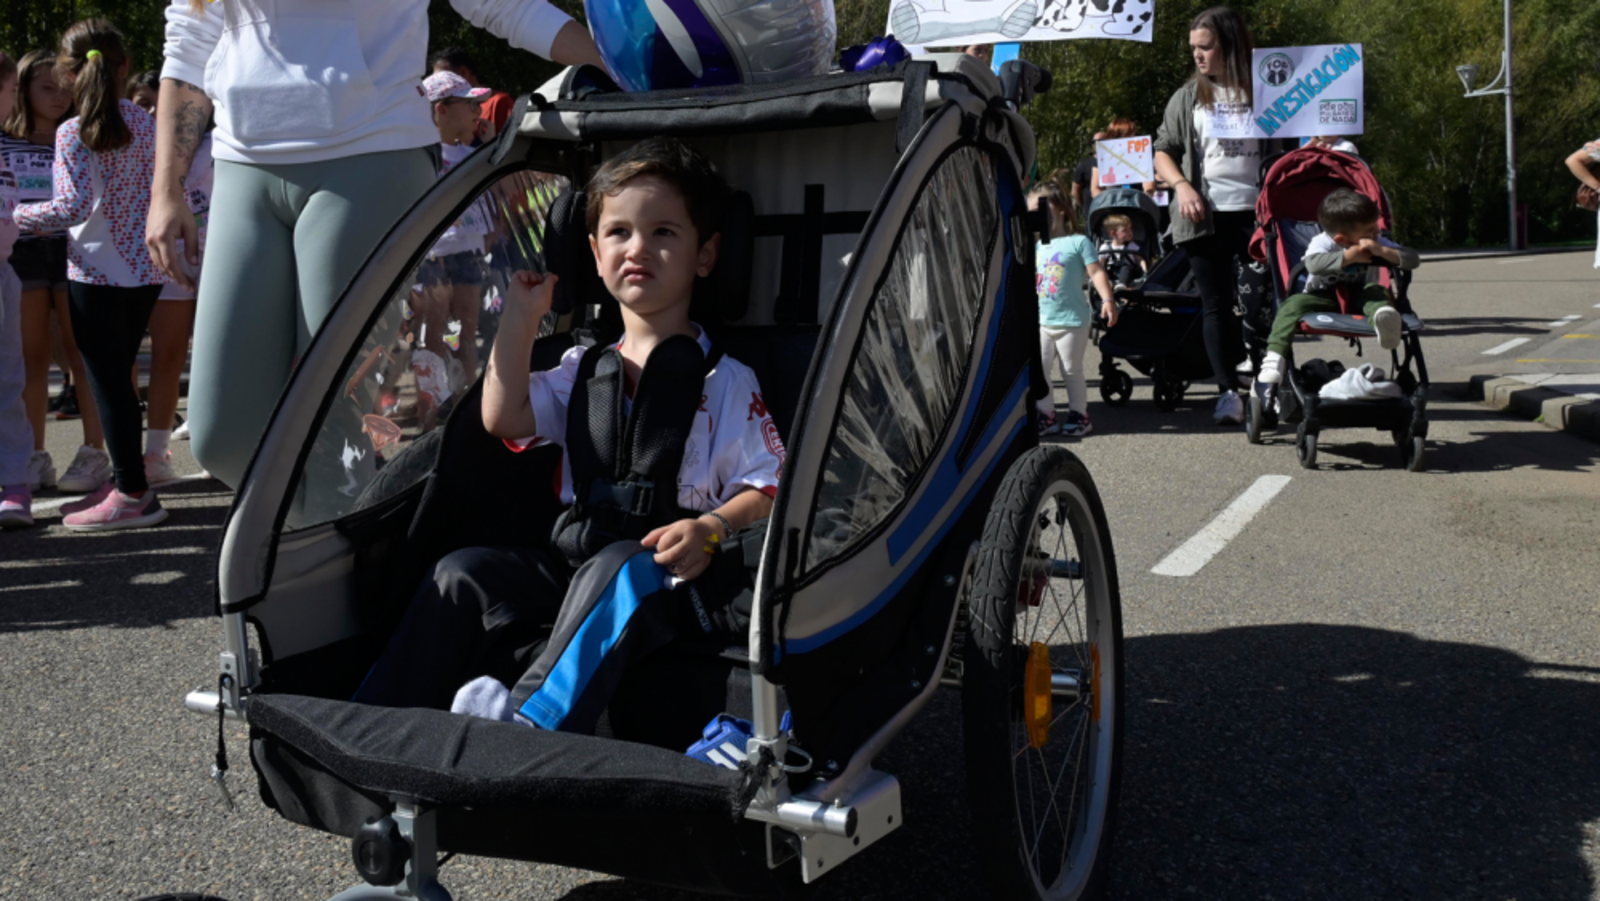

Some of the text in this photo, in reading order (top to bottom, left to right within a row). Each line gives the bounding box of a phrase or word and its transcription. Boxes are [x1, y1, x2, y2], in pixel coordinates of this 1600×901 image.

[1255, 44, 1360, 136] INVESTIGACIÓN
[1319, 102, 1336, 110] POR
[1127, 138, 1149, 154] FOP
